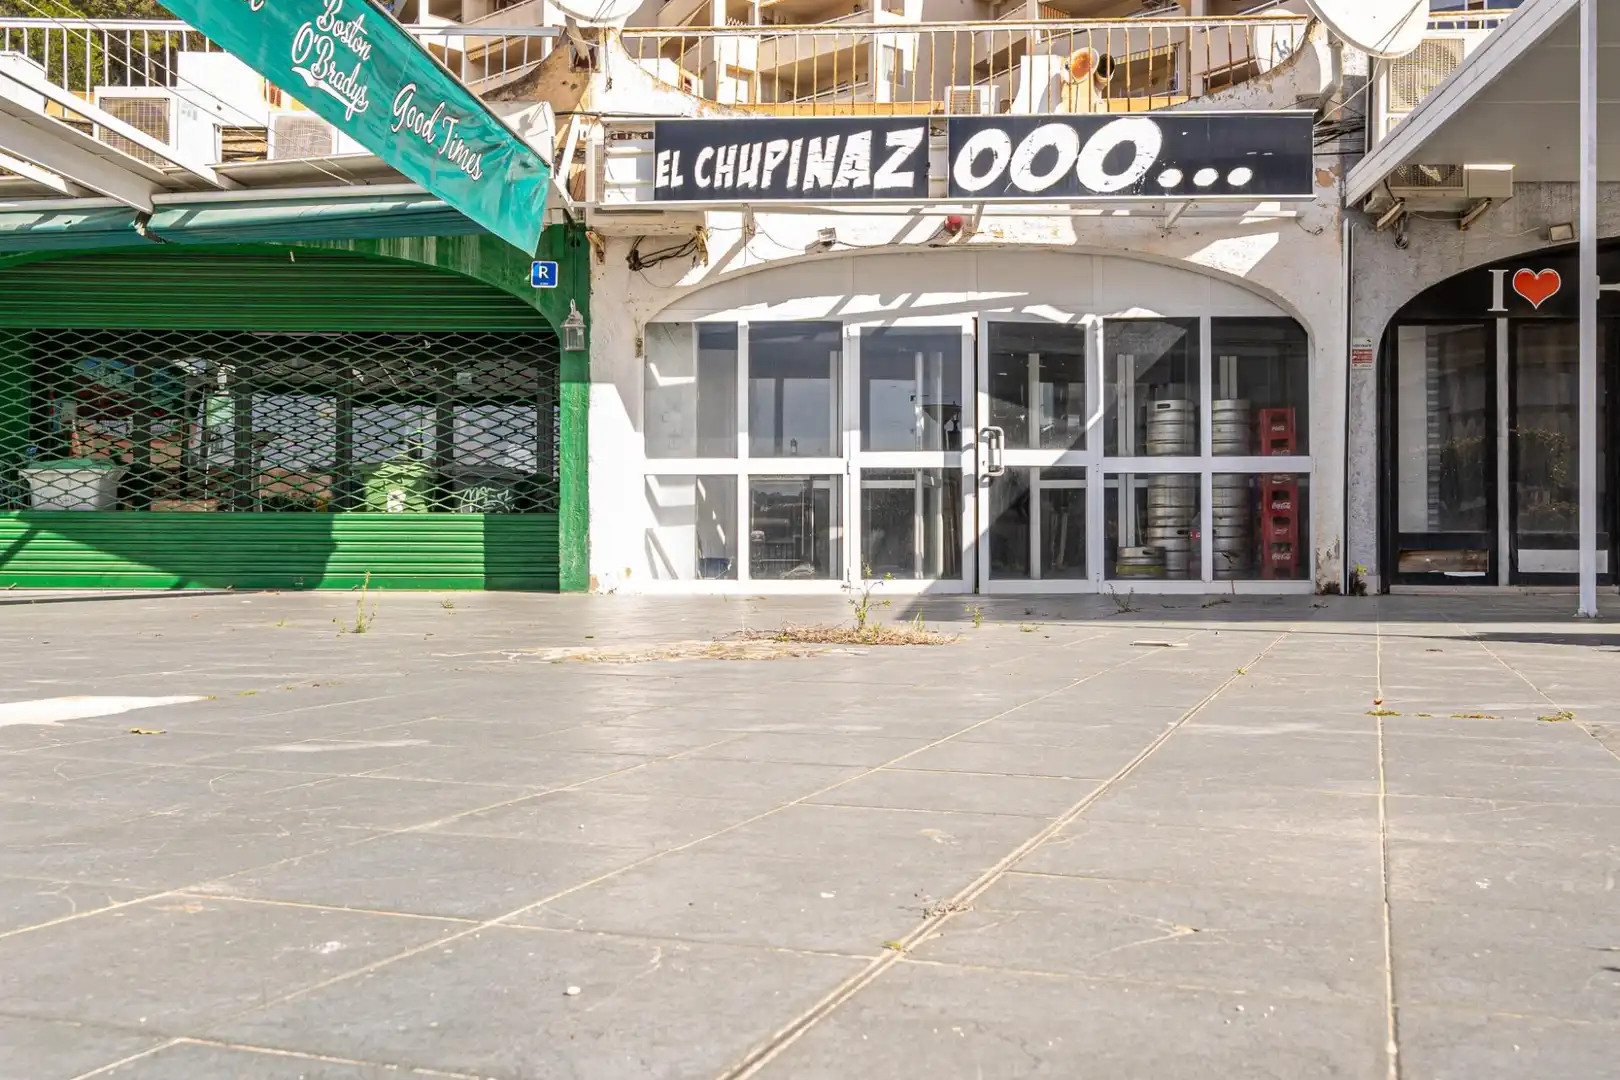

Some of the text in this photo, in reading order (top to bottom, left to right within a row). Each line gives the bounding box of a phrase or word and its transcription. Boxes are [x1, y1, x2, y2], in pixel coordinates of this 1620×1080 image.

[316, 0, 372, 61] Boston
[391, 83, 483, 181] Good Times
[655, 149, 683, 189] EL
[694, 127, 924, 191] CHUPINAZ
[538, 265, 549, 279] R
[1487, 269, 1509, 311] I
